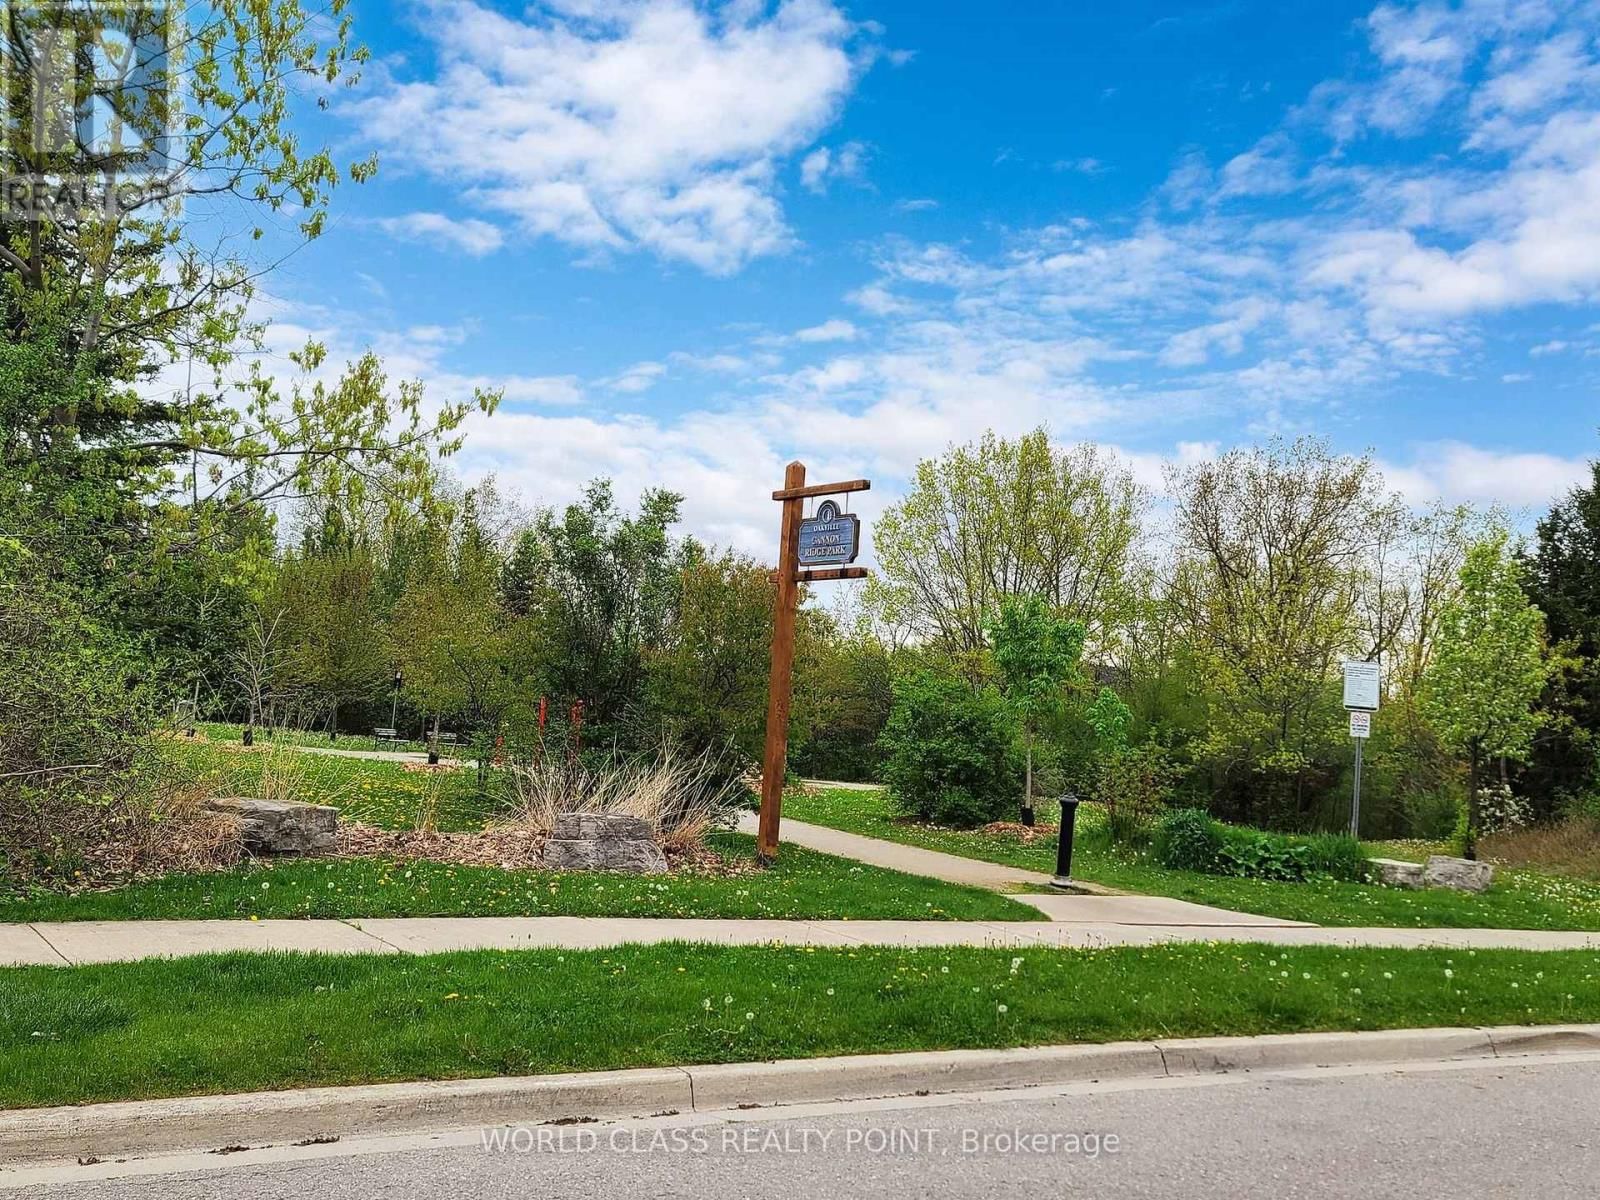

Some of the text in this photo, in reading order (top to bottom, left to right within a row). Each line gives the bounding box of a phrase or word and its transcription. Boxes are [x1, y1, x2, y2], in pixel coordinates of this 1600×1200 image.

[813, 523, 840, 532] OAKVILLE
[812, 534, 841, 545] CANNON
[804, 545, 846, 557] RIDGE PARK
